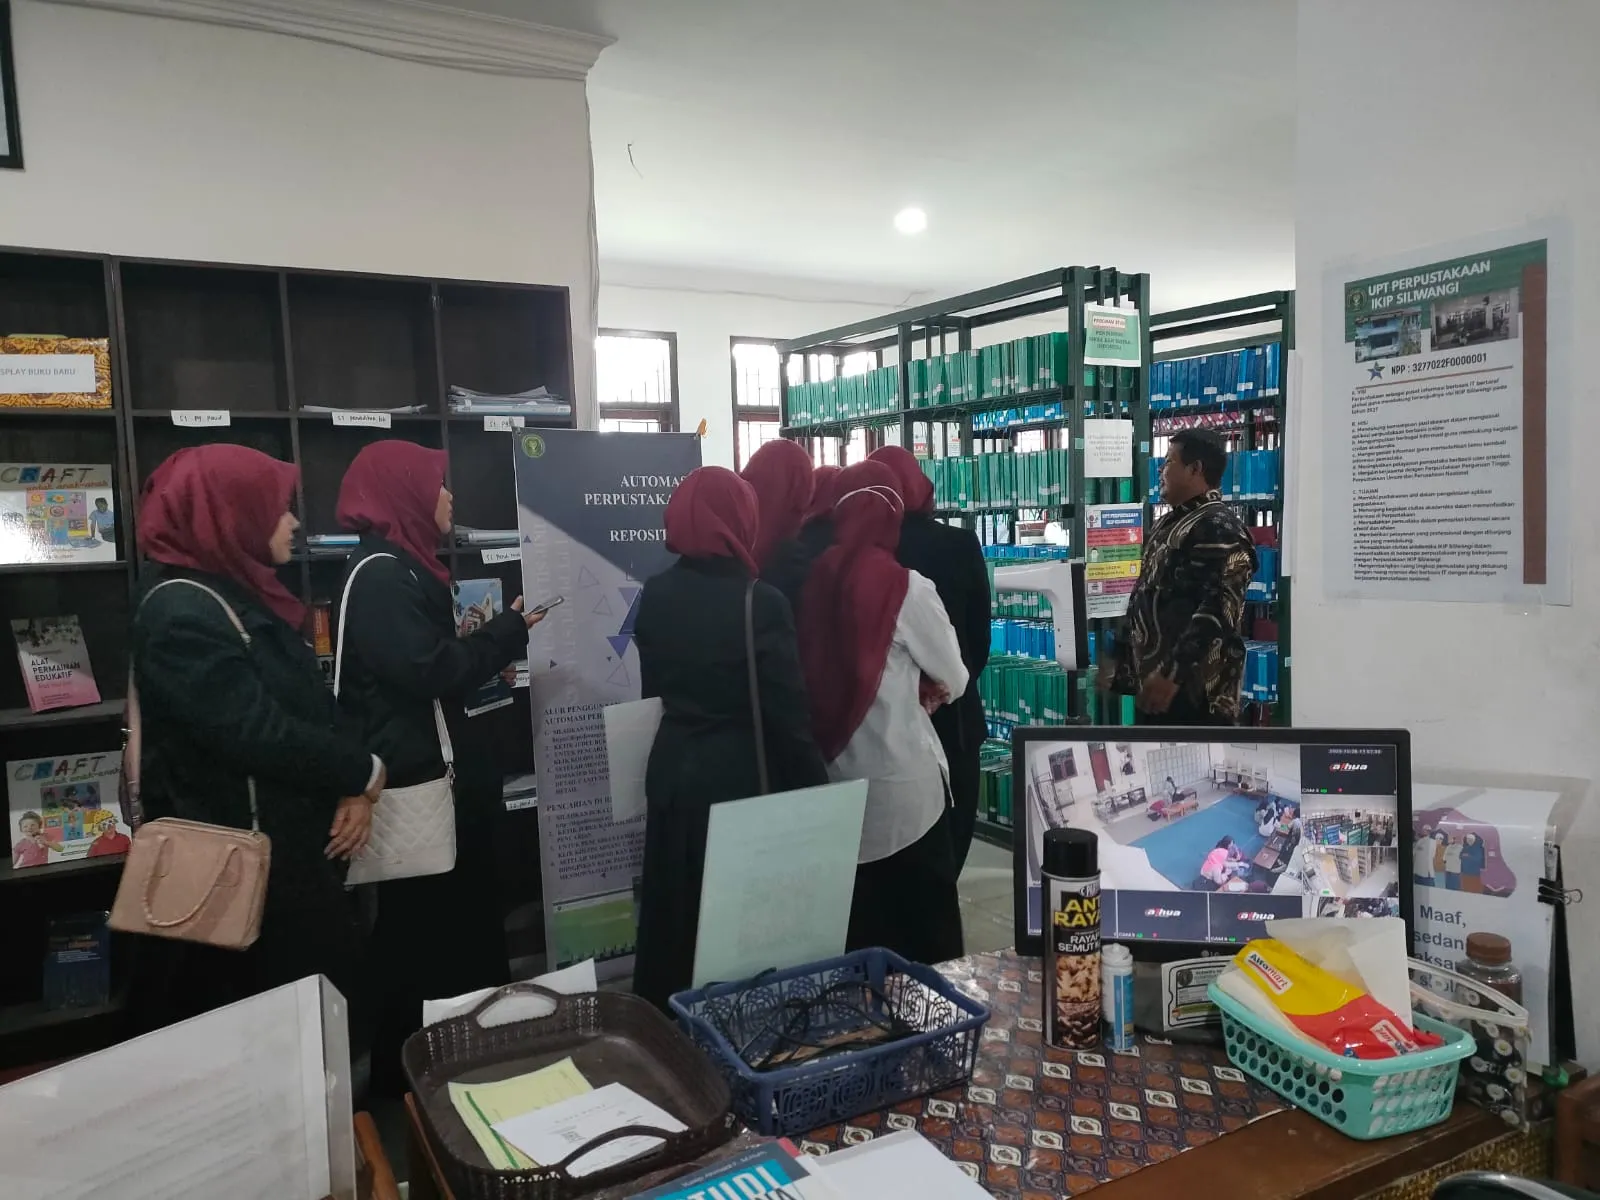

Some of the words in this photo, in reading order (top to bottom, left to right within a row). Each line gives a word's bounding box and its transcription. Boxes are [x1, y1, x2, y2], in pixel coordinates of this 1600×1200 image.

[1368, 281, 1389, 296] UPT
[1391, 260, 1491, 291] PERPUSTAKAAN
[1371, 295, 1394, 309] IKIP
[1396, 281, 1459, 305] SILIWANGI
[28, 368, 51, 376] BUKU
[53, 368, 76, 376] BARU
[1391, 364, 1406, 375] NPP
[1, 465, 95, 484] CRAFT
[31, 657, 49, 666] ALAT
[32, 661, 80, 674] PERMAINAN
[35, 671, 73, 682] EDUKATIF
[14, 755, 107, 781] CRAFT
[1419, 905, 1466, 929] Maaf,
[1058, 942, 1094, 953] SEMUT
[680, 1165, 781, 1200] TUDI
